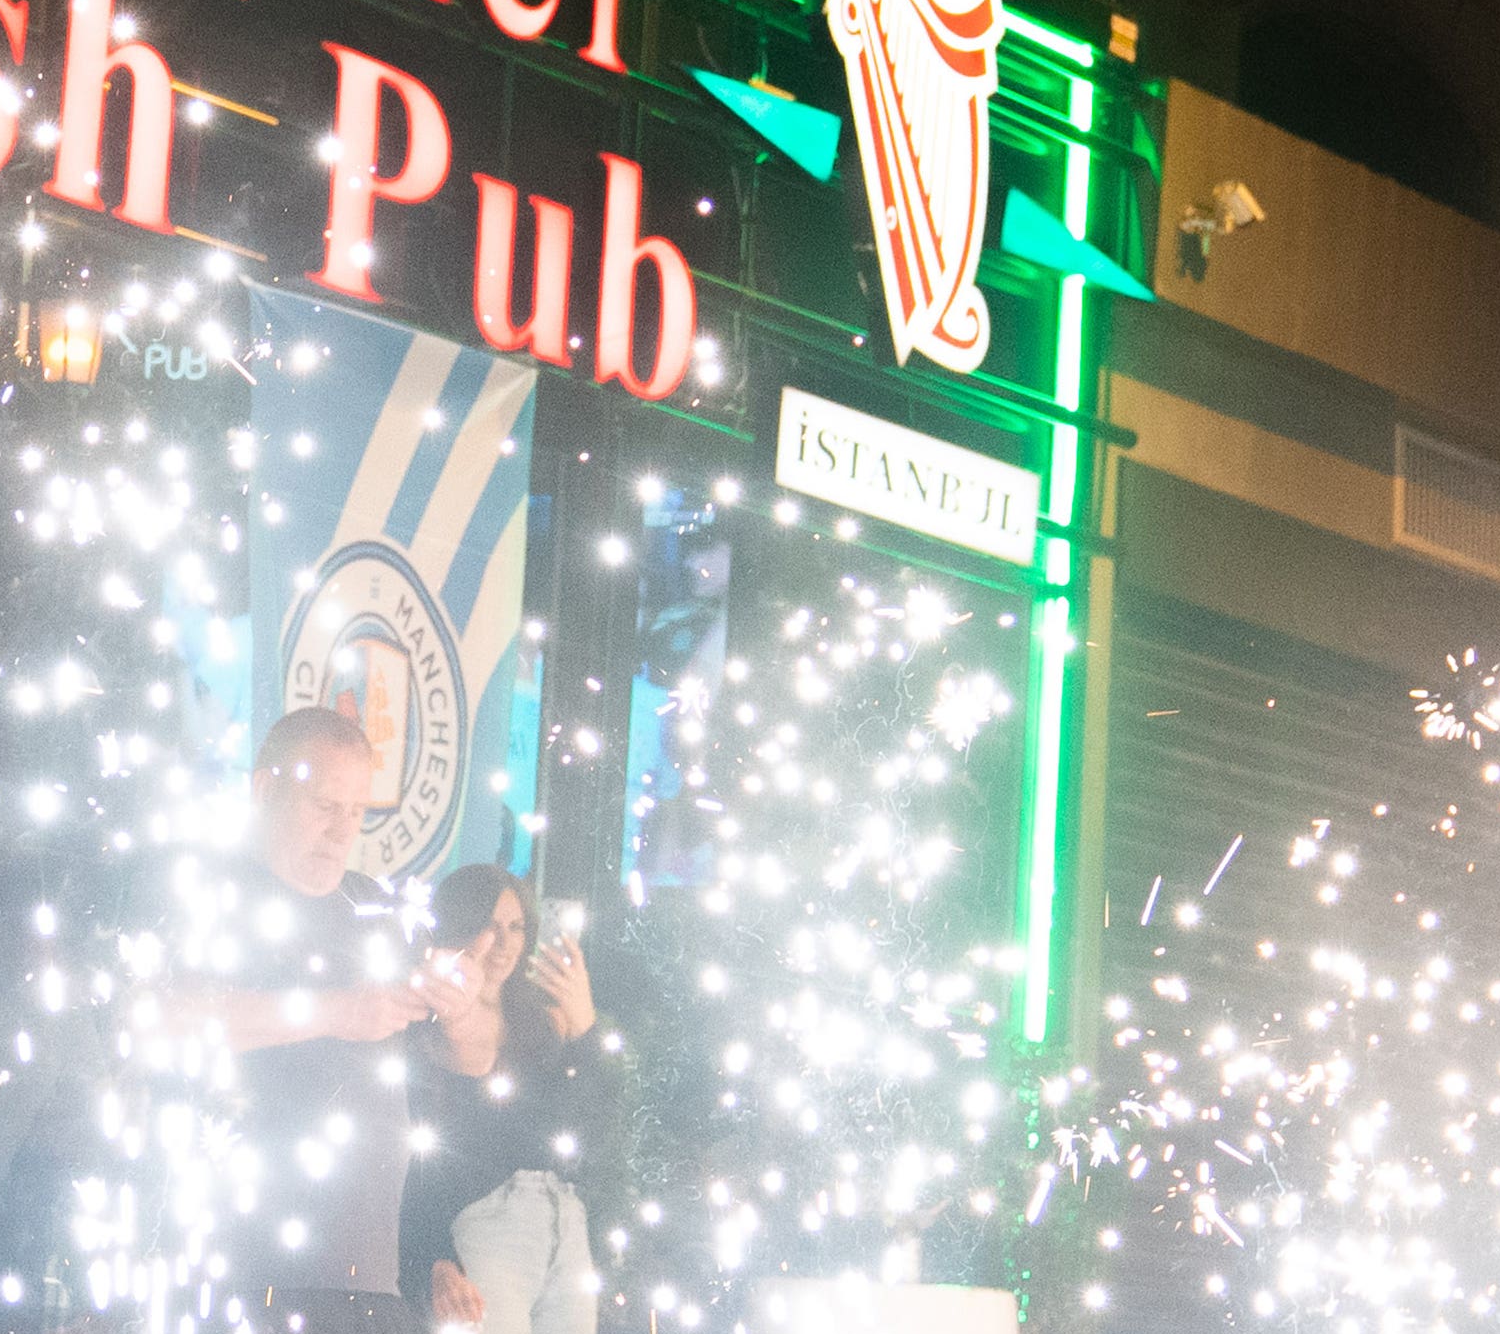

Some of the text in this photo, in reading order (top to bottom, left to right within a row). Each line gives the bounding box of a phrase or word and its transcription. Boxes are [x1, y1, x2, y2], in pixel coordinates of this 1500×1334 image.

[303, 40, 698, 402] Pub
[143, 341, 209, 381] PUB
[379, 593, 451, 865] MANCHESTER
